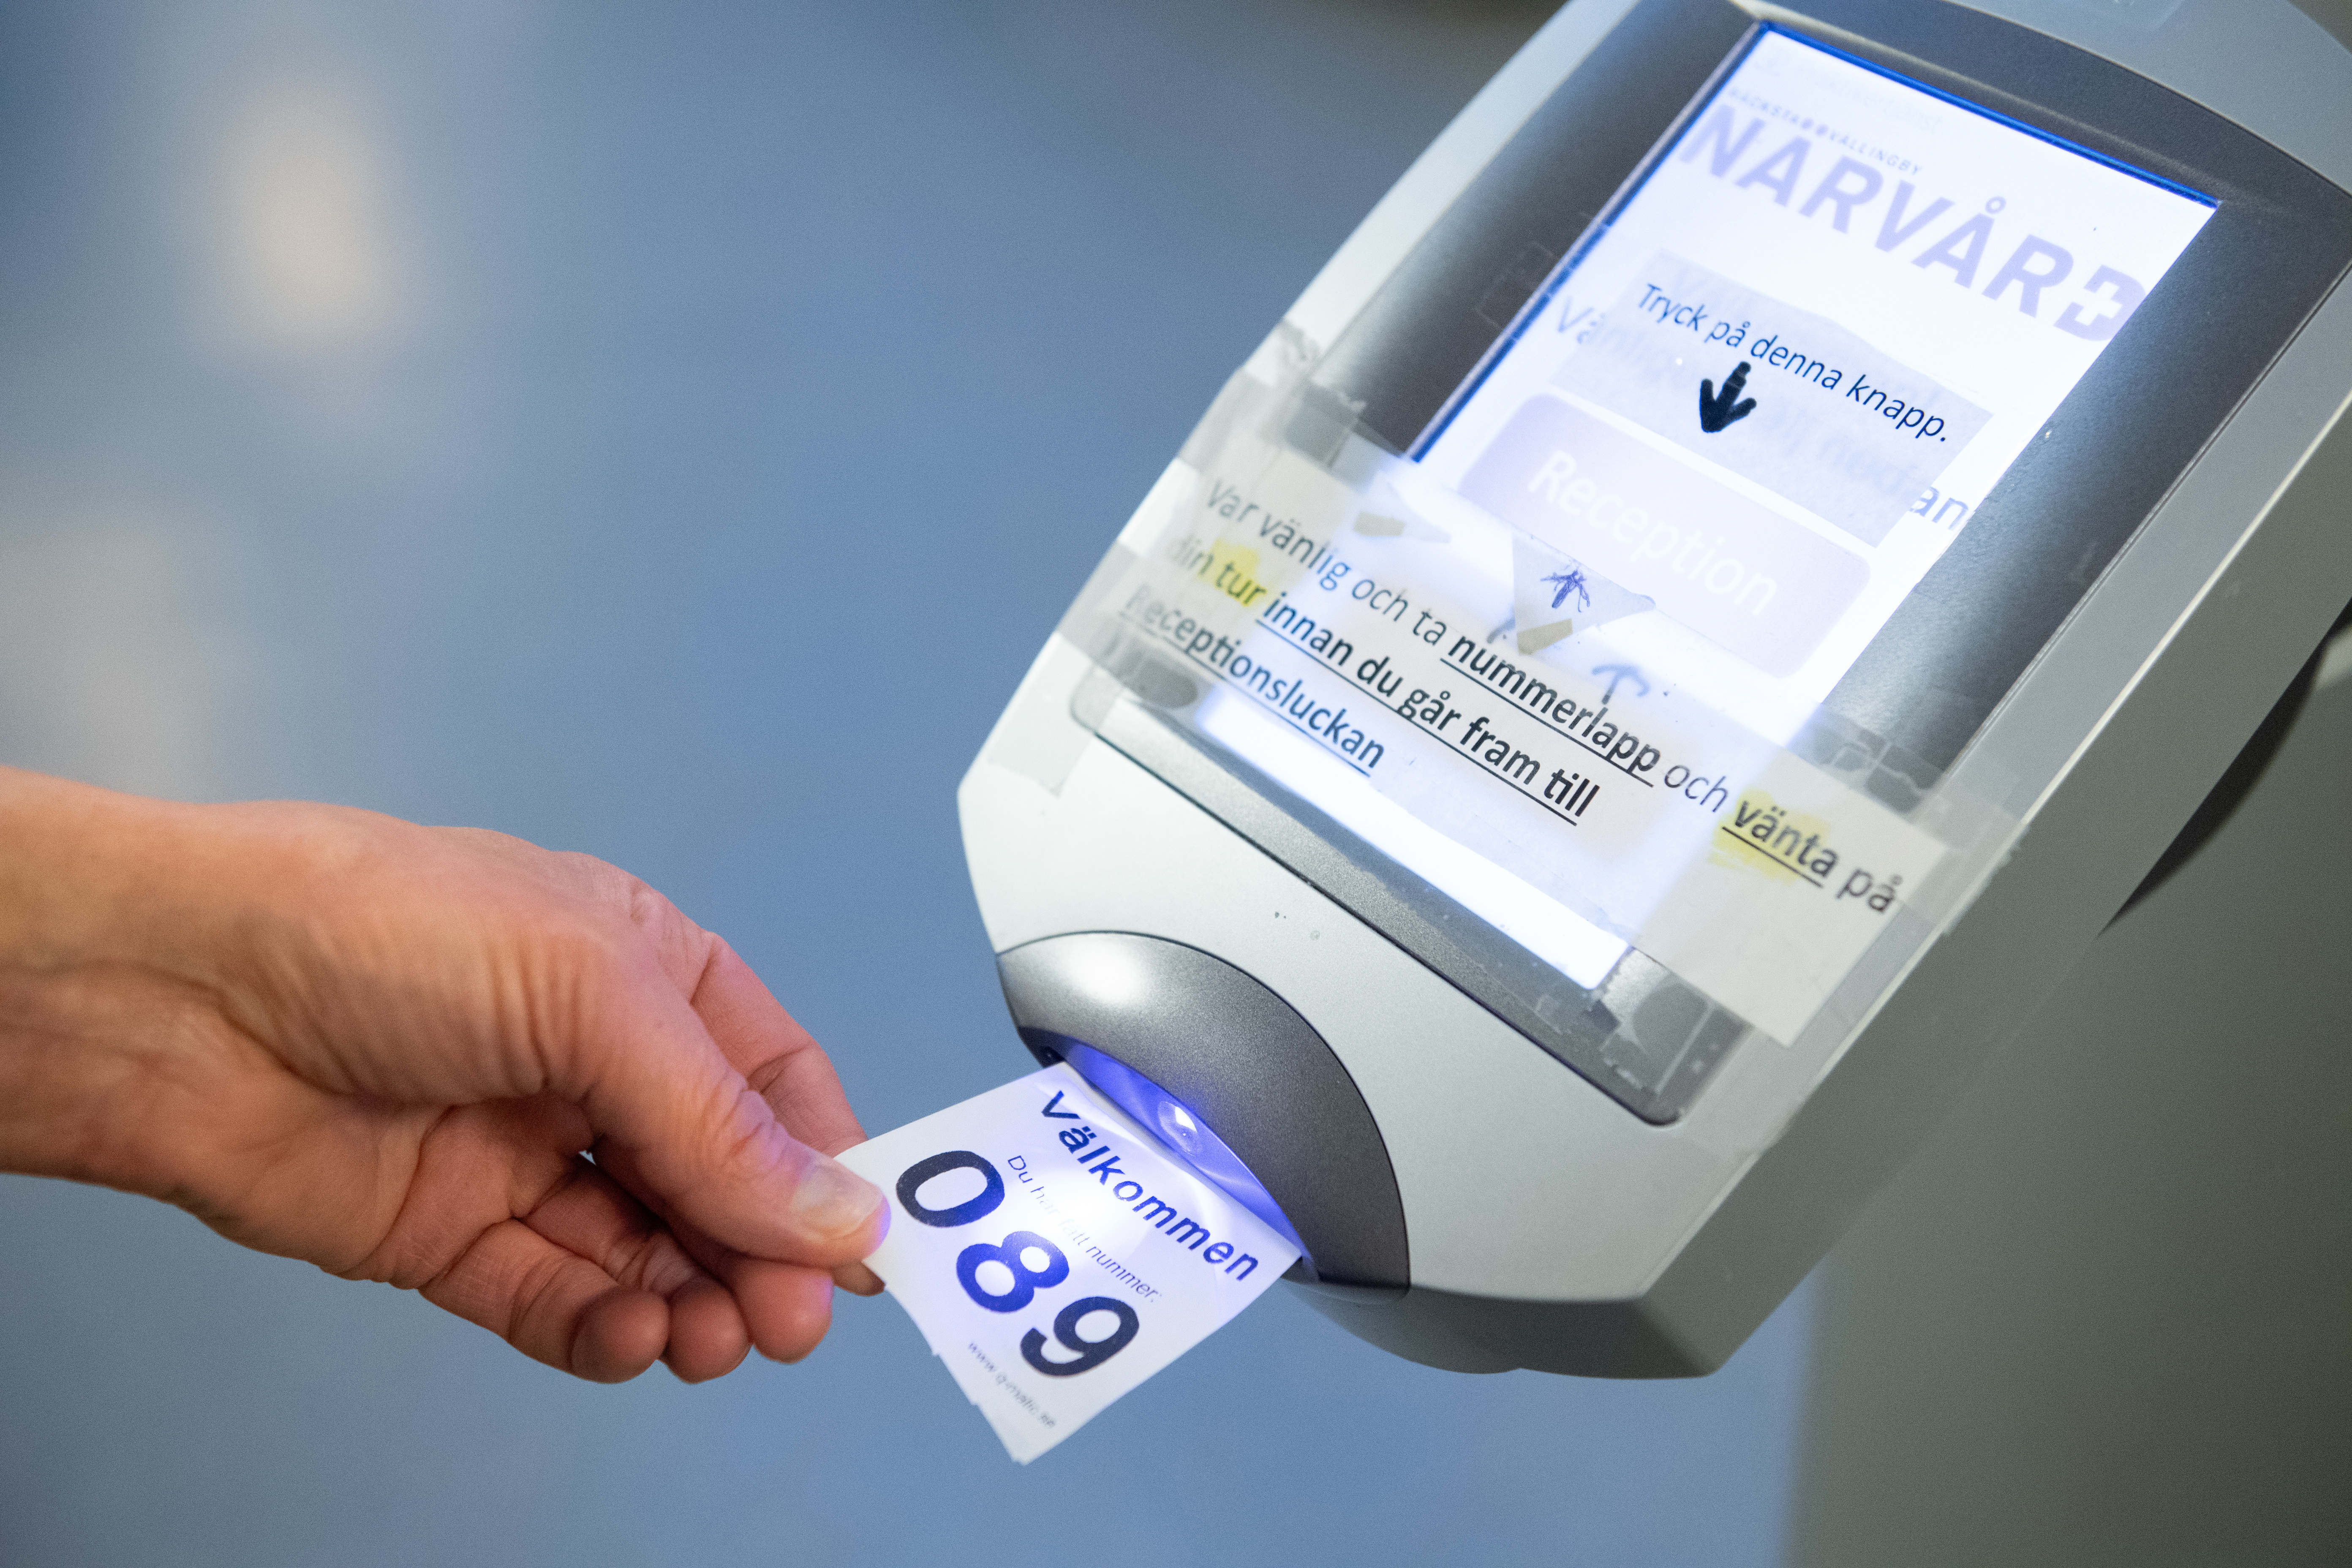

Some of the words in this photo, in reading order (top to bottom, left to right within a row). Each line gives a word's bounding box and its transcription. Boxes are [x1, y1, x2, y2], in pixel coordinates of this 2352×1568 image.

[1638, 283, 1709, 332] Tryck
[1703, 321, 1751, 348] på
[1750, 335, 1843, 389] denna
[1846, 374, 1946, 442] knapp.
[1527, 450, 1778, 616] Reception
[1207, 480, 1259, 523] Var
[1259, 513, 1352, 591] vänlig
[1351, 579, 1409, 621] och
[1413, 608, 1447, 646] ta
[1447, 635, 1661, 776] nummerlapp
[1663, 764, 1729, 813] och
[1734, 801, 1839, 879] vänta
[1835, 868, 1903, 914] på
[1214, 561, 1267, 605] tur
[1262, 591, 1353, 667] innan
[1356, 656, 1403, 698] du
[1397, 689, 1462, 731] går
[1460, 716, 1541, 786] fram
[1544, 768, 1601, 817] till
[895, 1150, 1140, 1378] 089
[1007, 1155, 1033, 1183] Du
[1040, 1090, 1259, 1282] Välkommen
